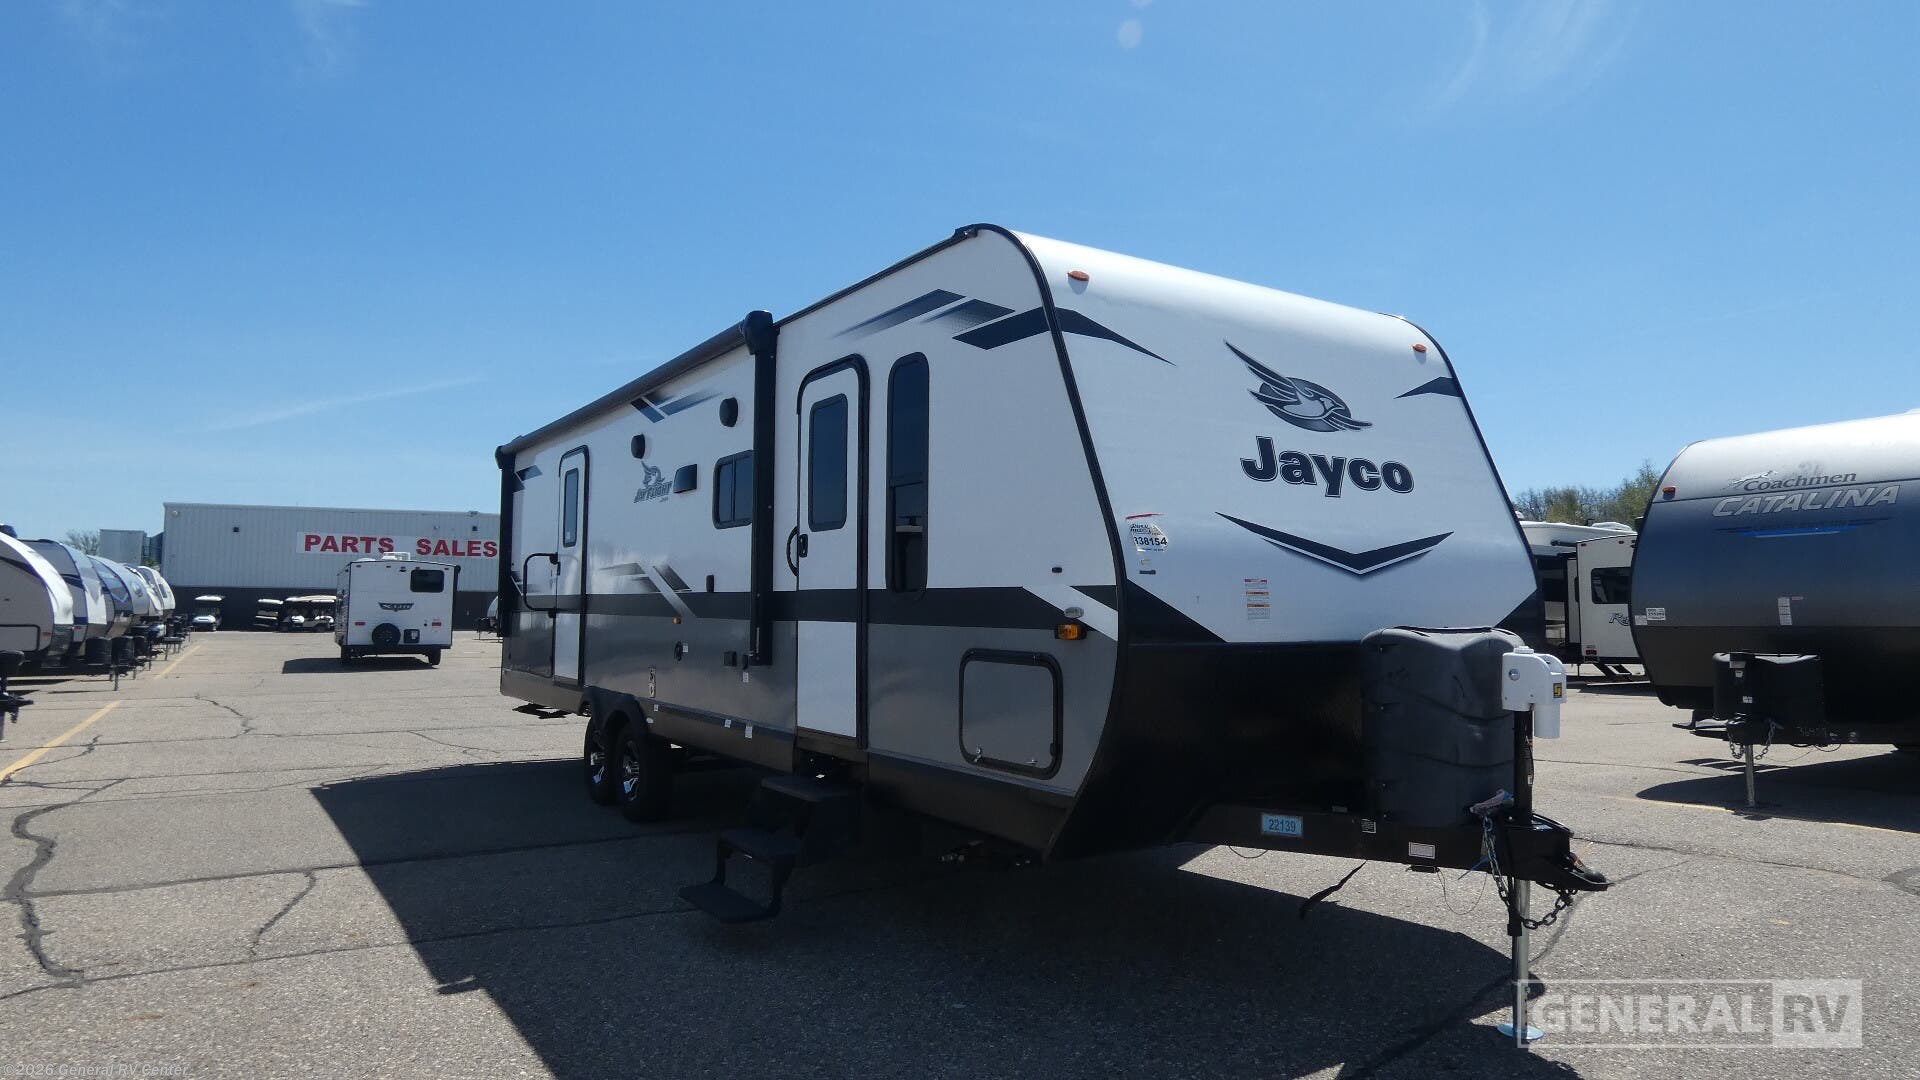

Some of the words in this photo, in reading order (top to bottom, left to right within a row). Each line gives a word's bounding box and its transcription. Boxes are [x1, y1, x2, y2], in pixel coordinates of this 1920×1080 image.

[1239, 435, 1415, 498] Jayco
[1743, 472, 1857, 492] Coachmen
[1711, 484, 1901, 517] CATALINA
[304, 534, 394, 554] PARTS
[416, 538, 498, 558] SALES
[1268, 818, 1297, 833] 22139
